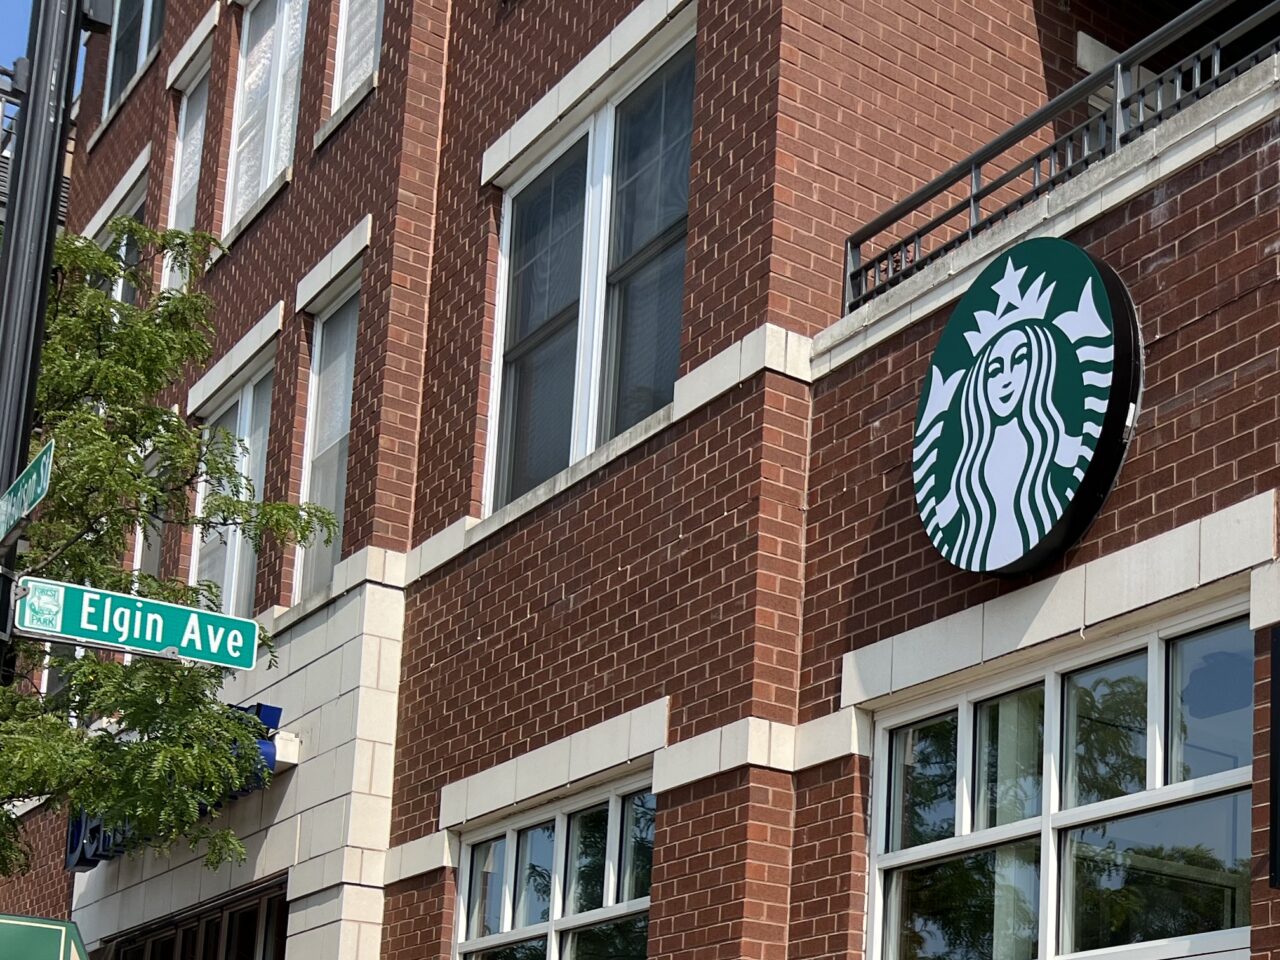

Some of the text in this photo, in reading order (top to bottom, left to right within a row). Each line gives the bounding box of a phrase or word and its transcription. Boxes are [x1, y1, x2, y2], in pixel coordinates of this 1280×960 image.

[31, 613, 55, 628] PARK
[80, 592, 243, 658] Elgin Ave
